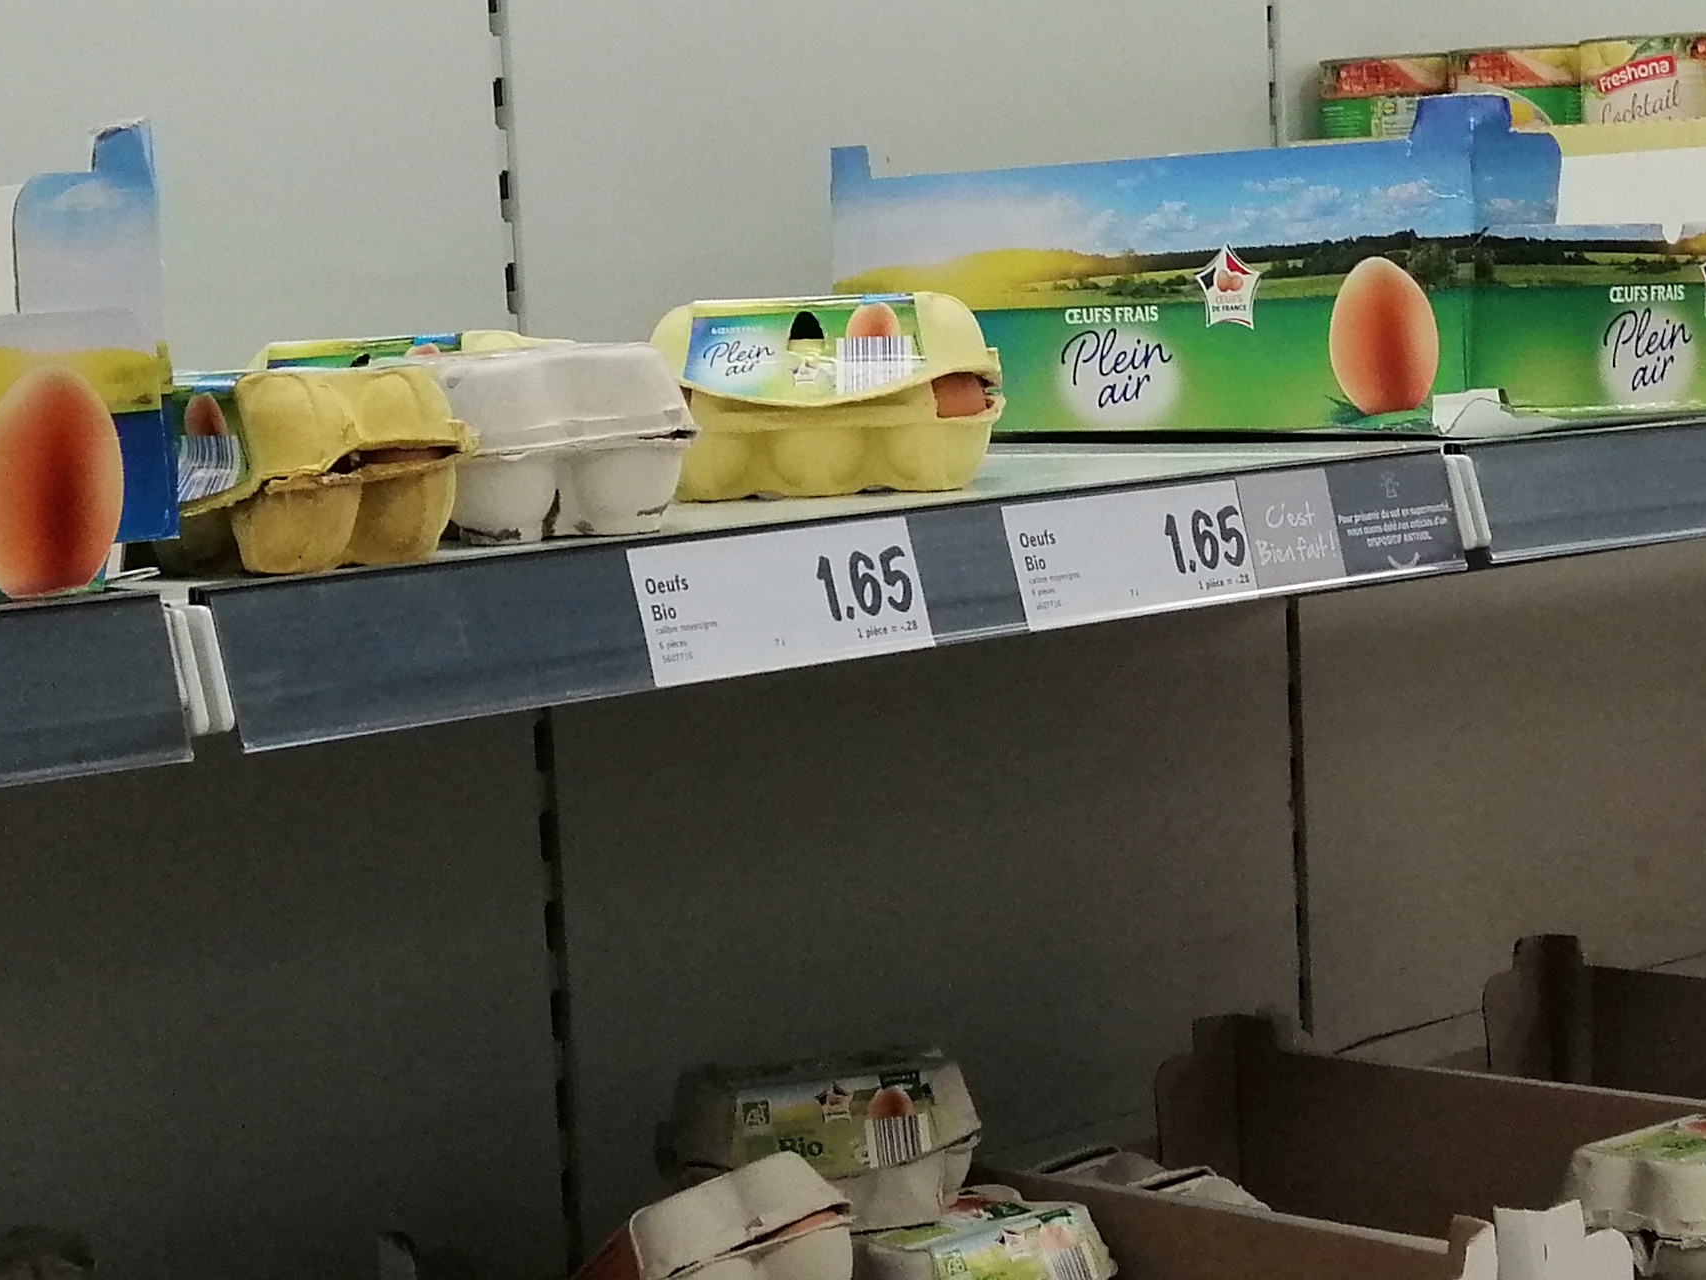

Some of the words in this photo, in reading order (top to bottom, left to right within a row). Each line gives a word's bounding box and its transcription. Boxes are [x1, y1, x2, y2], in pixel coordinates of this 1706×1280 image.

[1599, 60, 1670, 92] Freshona
[1610, 285, 1648, 303] ŒUFS
[1651, 285, 1685, 302] FRAIS
[1065, 307, 1111, 324] ŒUFS
[1116, 305, 1159, 322] FRAIS
[1222, 304, 1247, 312] FRANCE
[1603, 308, 1692, 368] Plein
[703, 340, 775, 368] Plein
[1061, 328, 1172, 386] Plein
[725, 360, 761, 377] air
[1632, 355, 1674, 391] air
[1098, 374, 1150, 408] air
[1265, 501, 1314, 528] C'est
[1020, 530, 1056, 548] Oeufs
[1164, 505, 1246, 574] 1.65
[1025, 556, 1046, 571] Bio
[645, 574, 689, 595] Oeufs
[816, 546, 913, 622] 1.65
[651, 604, 677, 621] Bio
